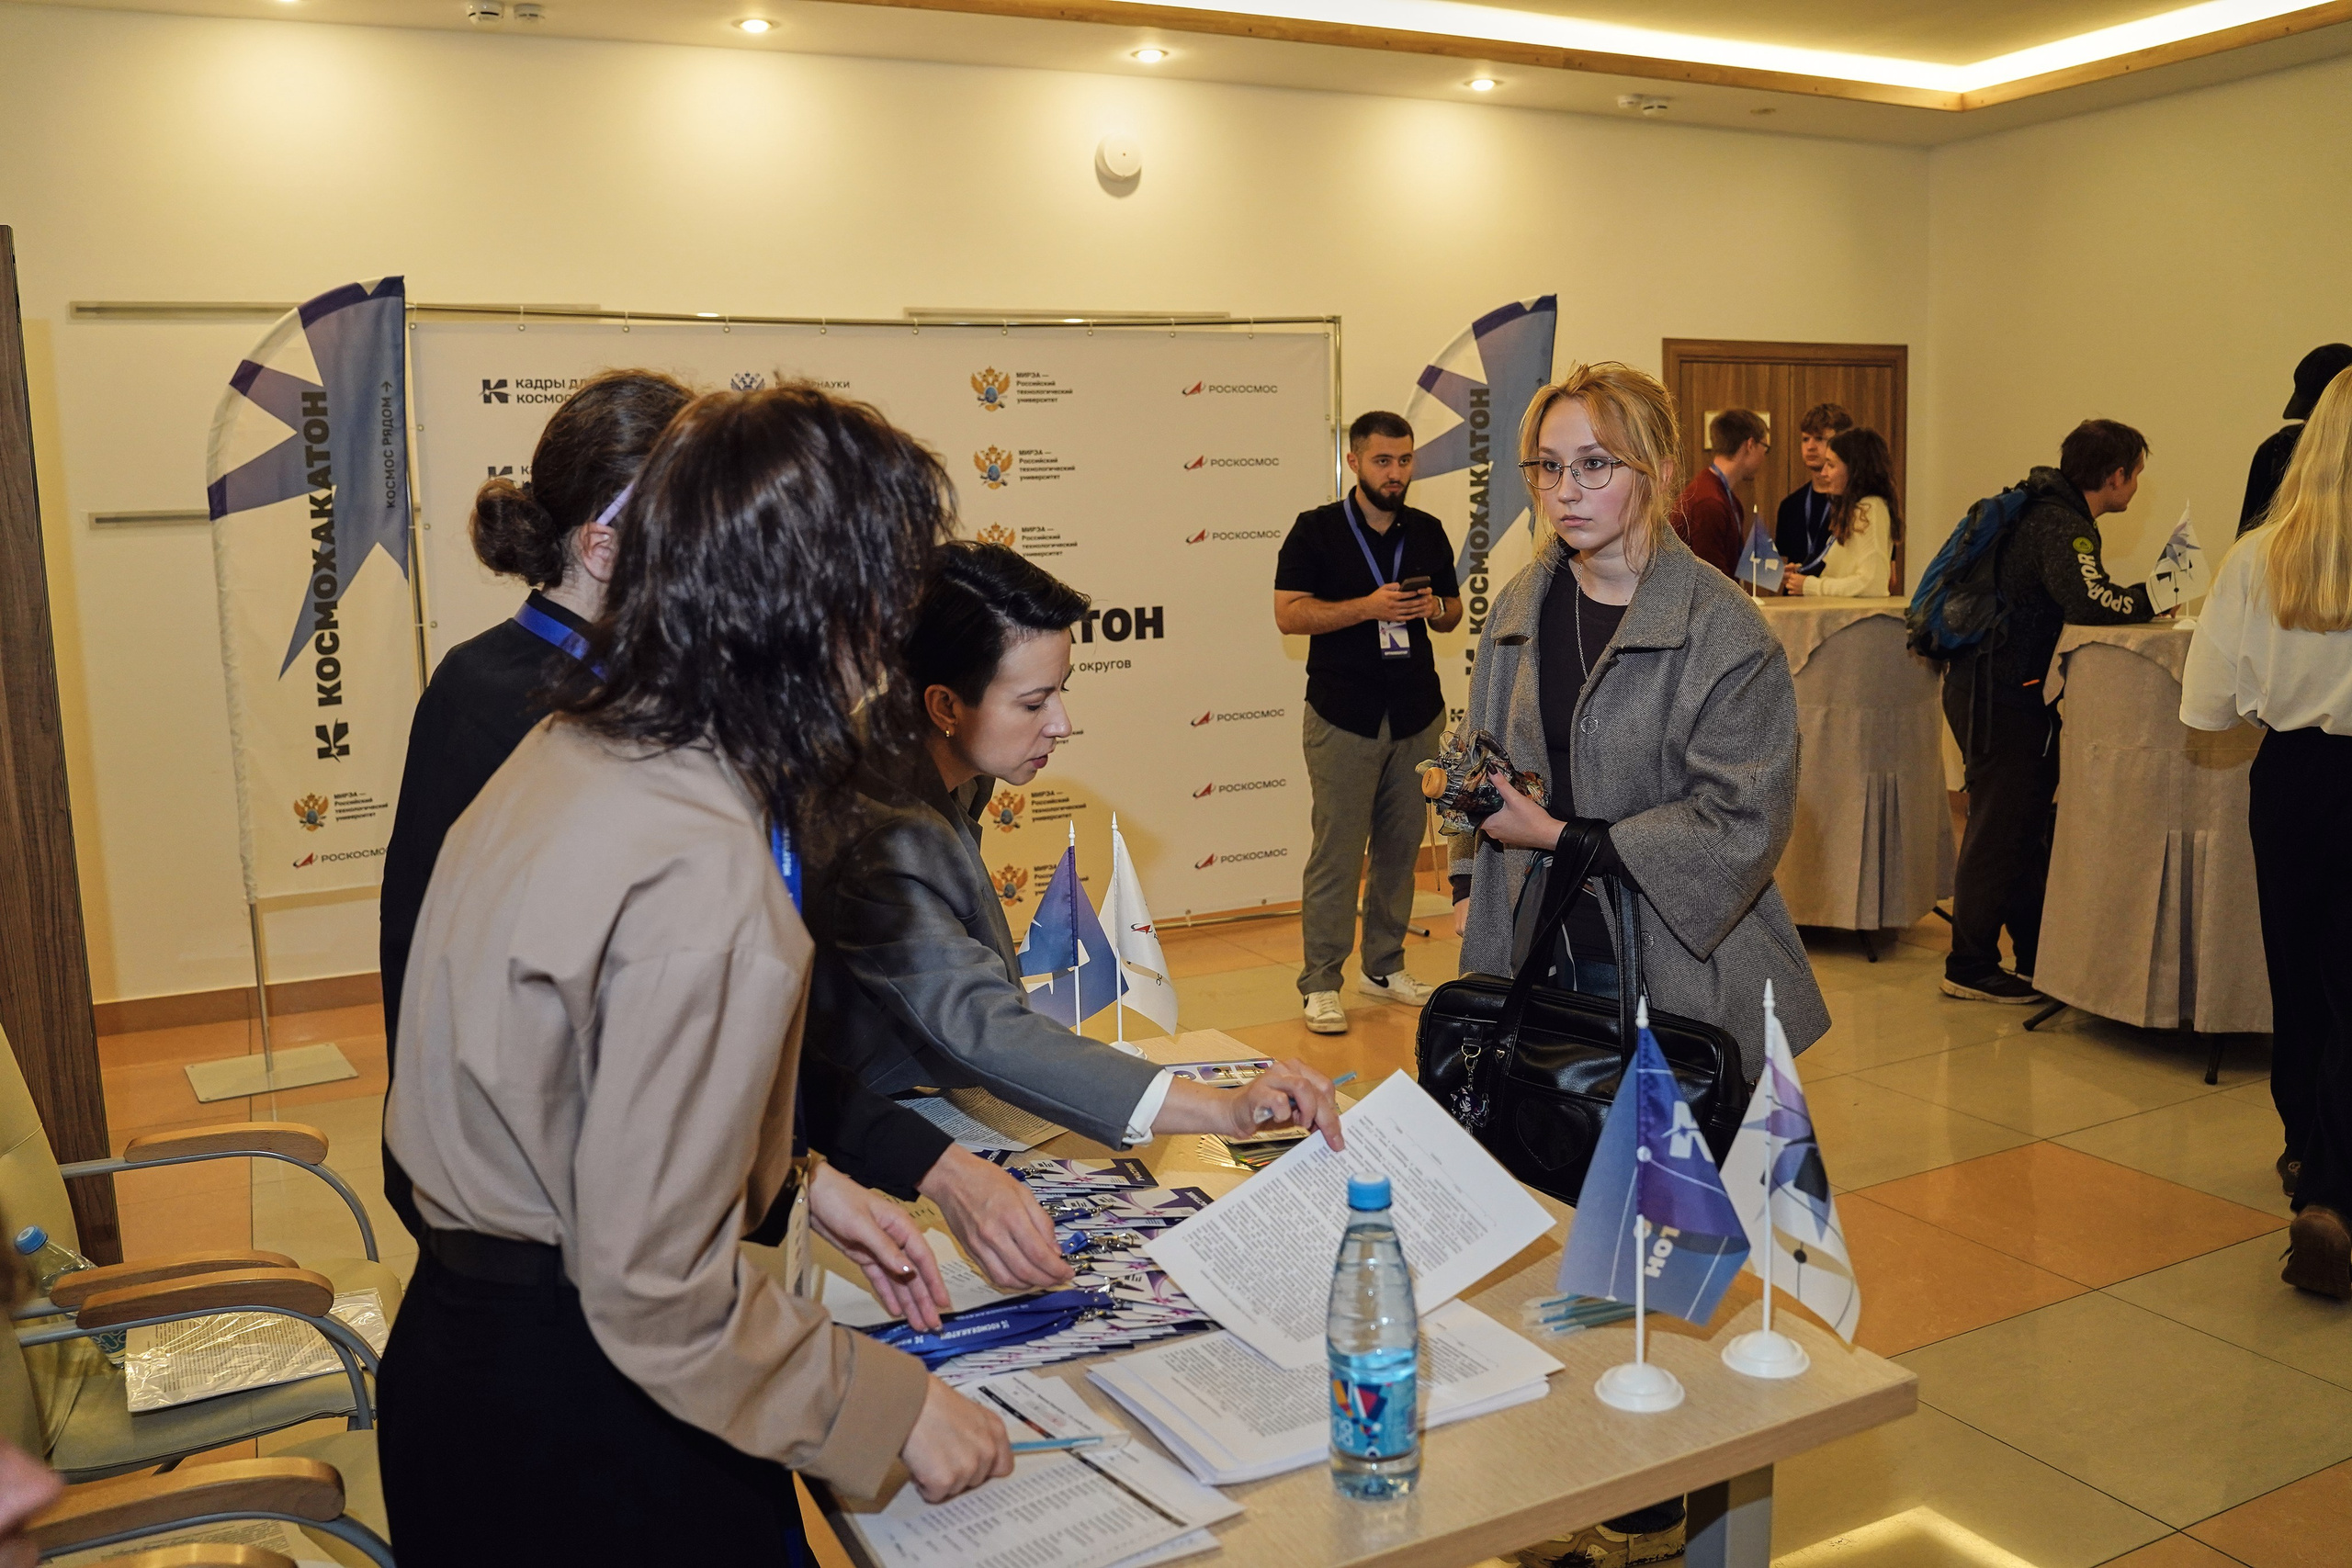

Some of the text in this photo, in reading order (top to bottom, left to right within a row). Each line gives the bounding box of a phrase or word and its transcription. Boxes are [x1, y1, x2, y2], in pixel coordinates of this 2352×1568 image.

[516, 378, 565, 391] кадры
[1208, 385, 1278, 394] РОСКОСМОС
[516, 393, 572, 404] космос
[381, 397, 397, 509] КОСМОС РЯДОМ
[1210, 457, 1280, 468] РОСКОСМОС
[1469, 388, 1490, 636] КОСМОХАКАТОН
[1212, 530, 1282, 541] РОСКОСМОС
[302, 391, 343, 706] КОСМОХАКАТОН
[1069, 605, 1164, 644] ТОН
[1080, 660, 1132, 673] округов
[1216, 708, 1285, 722] РОСКОСМОС
[1218, 778, 1287, 794] РОСКОСМОС
[321, 847, 388, 863] РОСКОСМО
[1220, 847, 1288, 863] РОСКОСМОС
